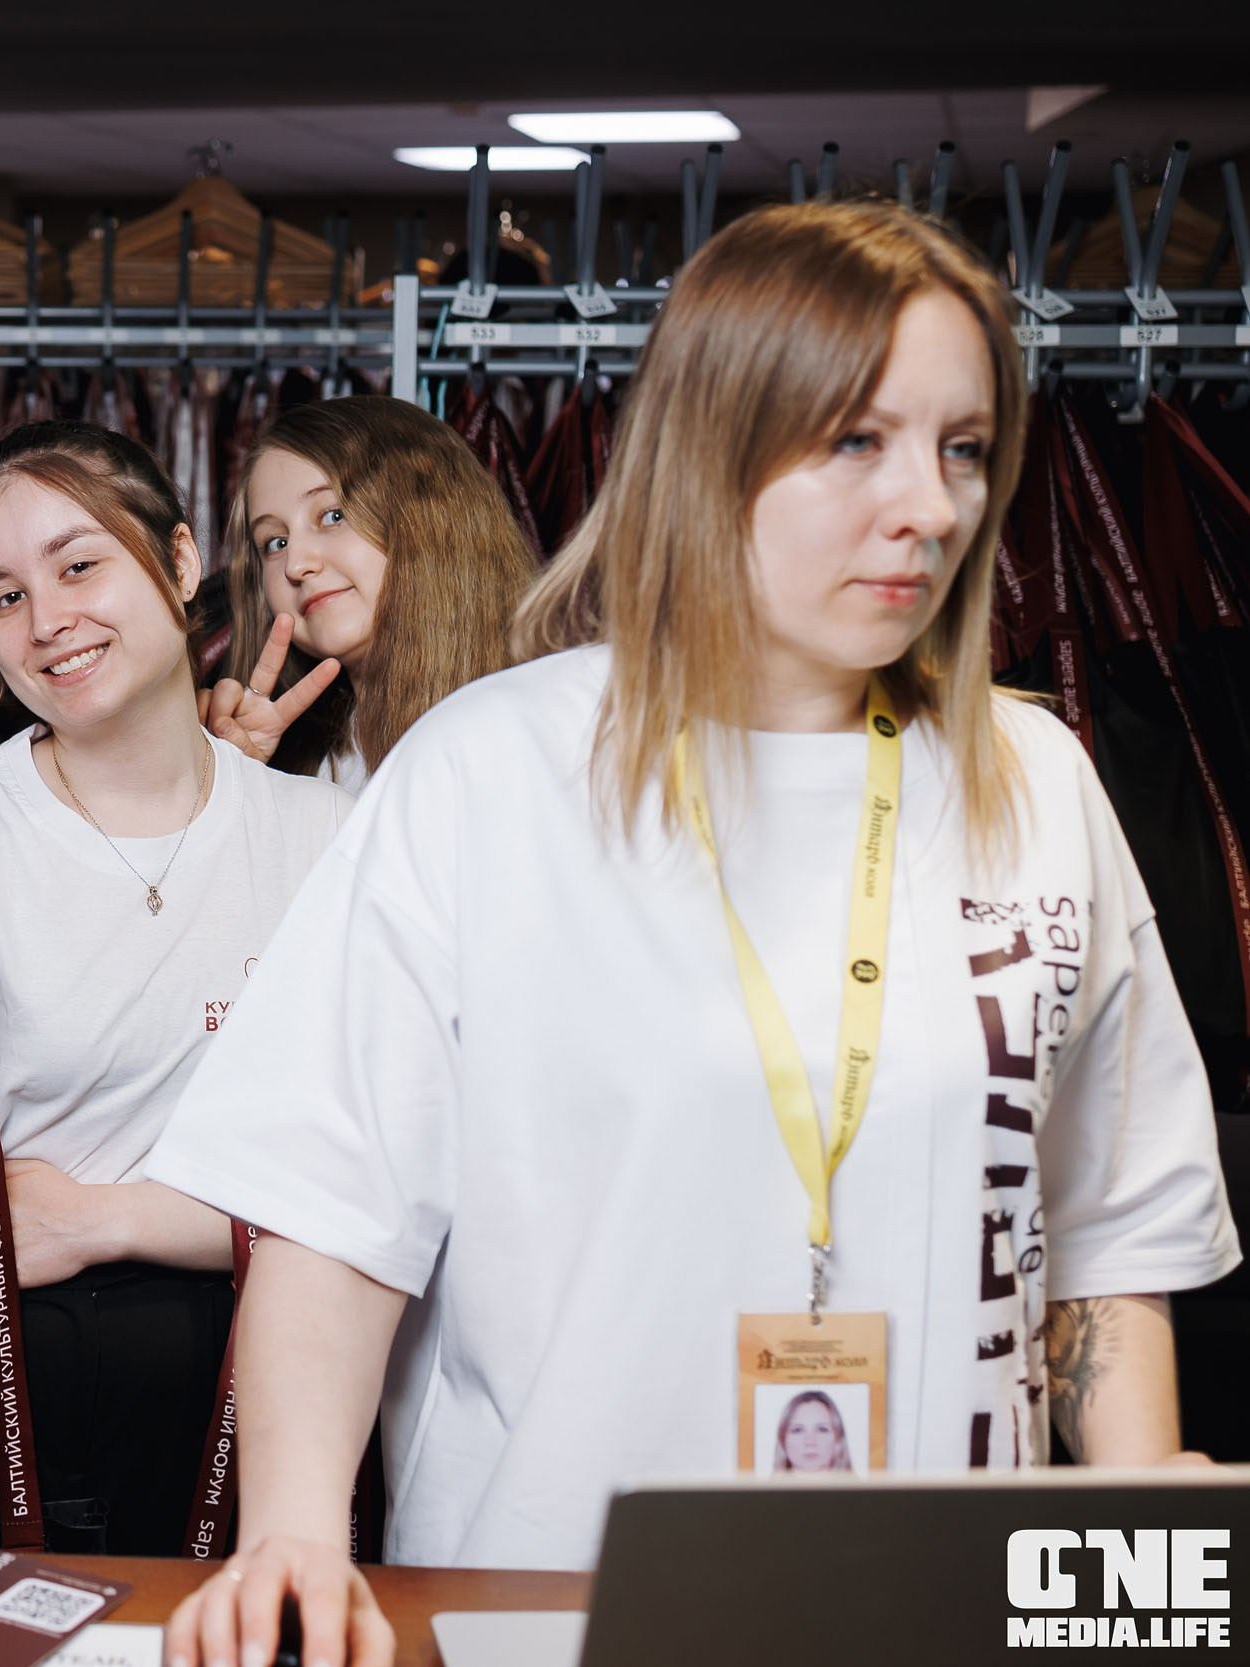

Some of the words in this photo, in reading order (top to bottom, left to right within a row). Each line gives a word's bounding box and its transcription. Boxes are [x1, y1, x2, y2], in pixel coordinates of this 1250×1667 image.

[205, 1001, 235, 1014] КУ
[0, 1386, 28, 1517] БАЛТИЙСКИЙ
[205, 1437, 232, 1505] ФОРУМ
[190, 1519, 215, 1562] sap
